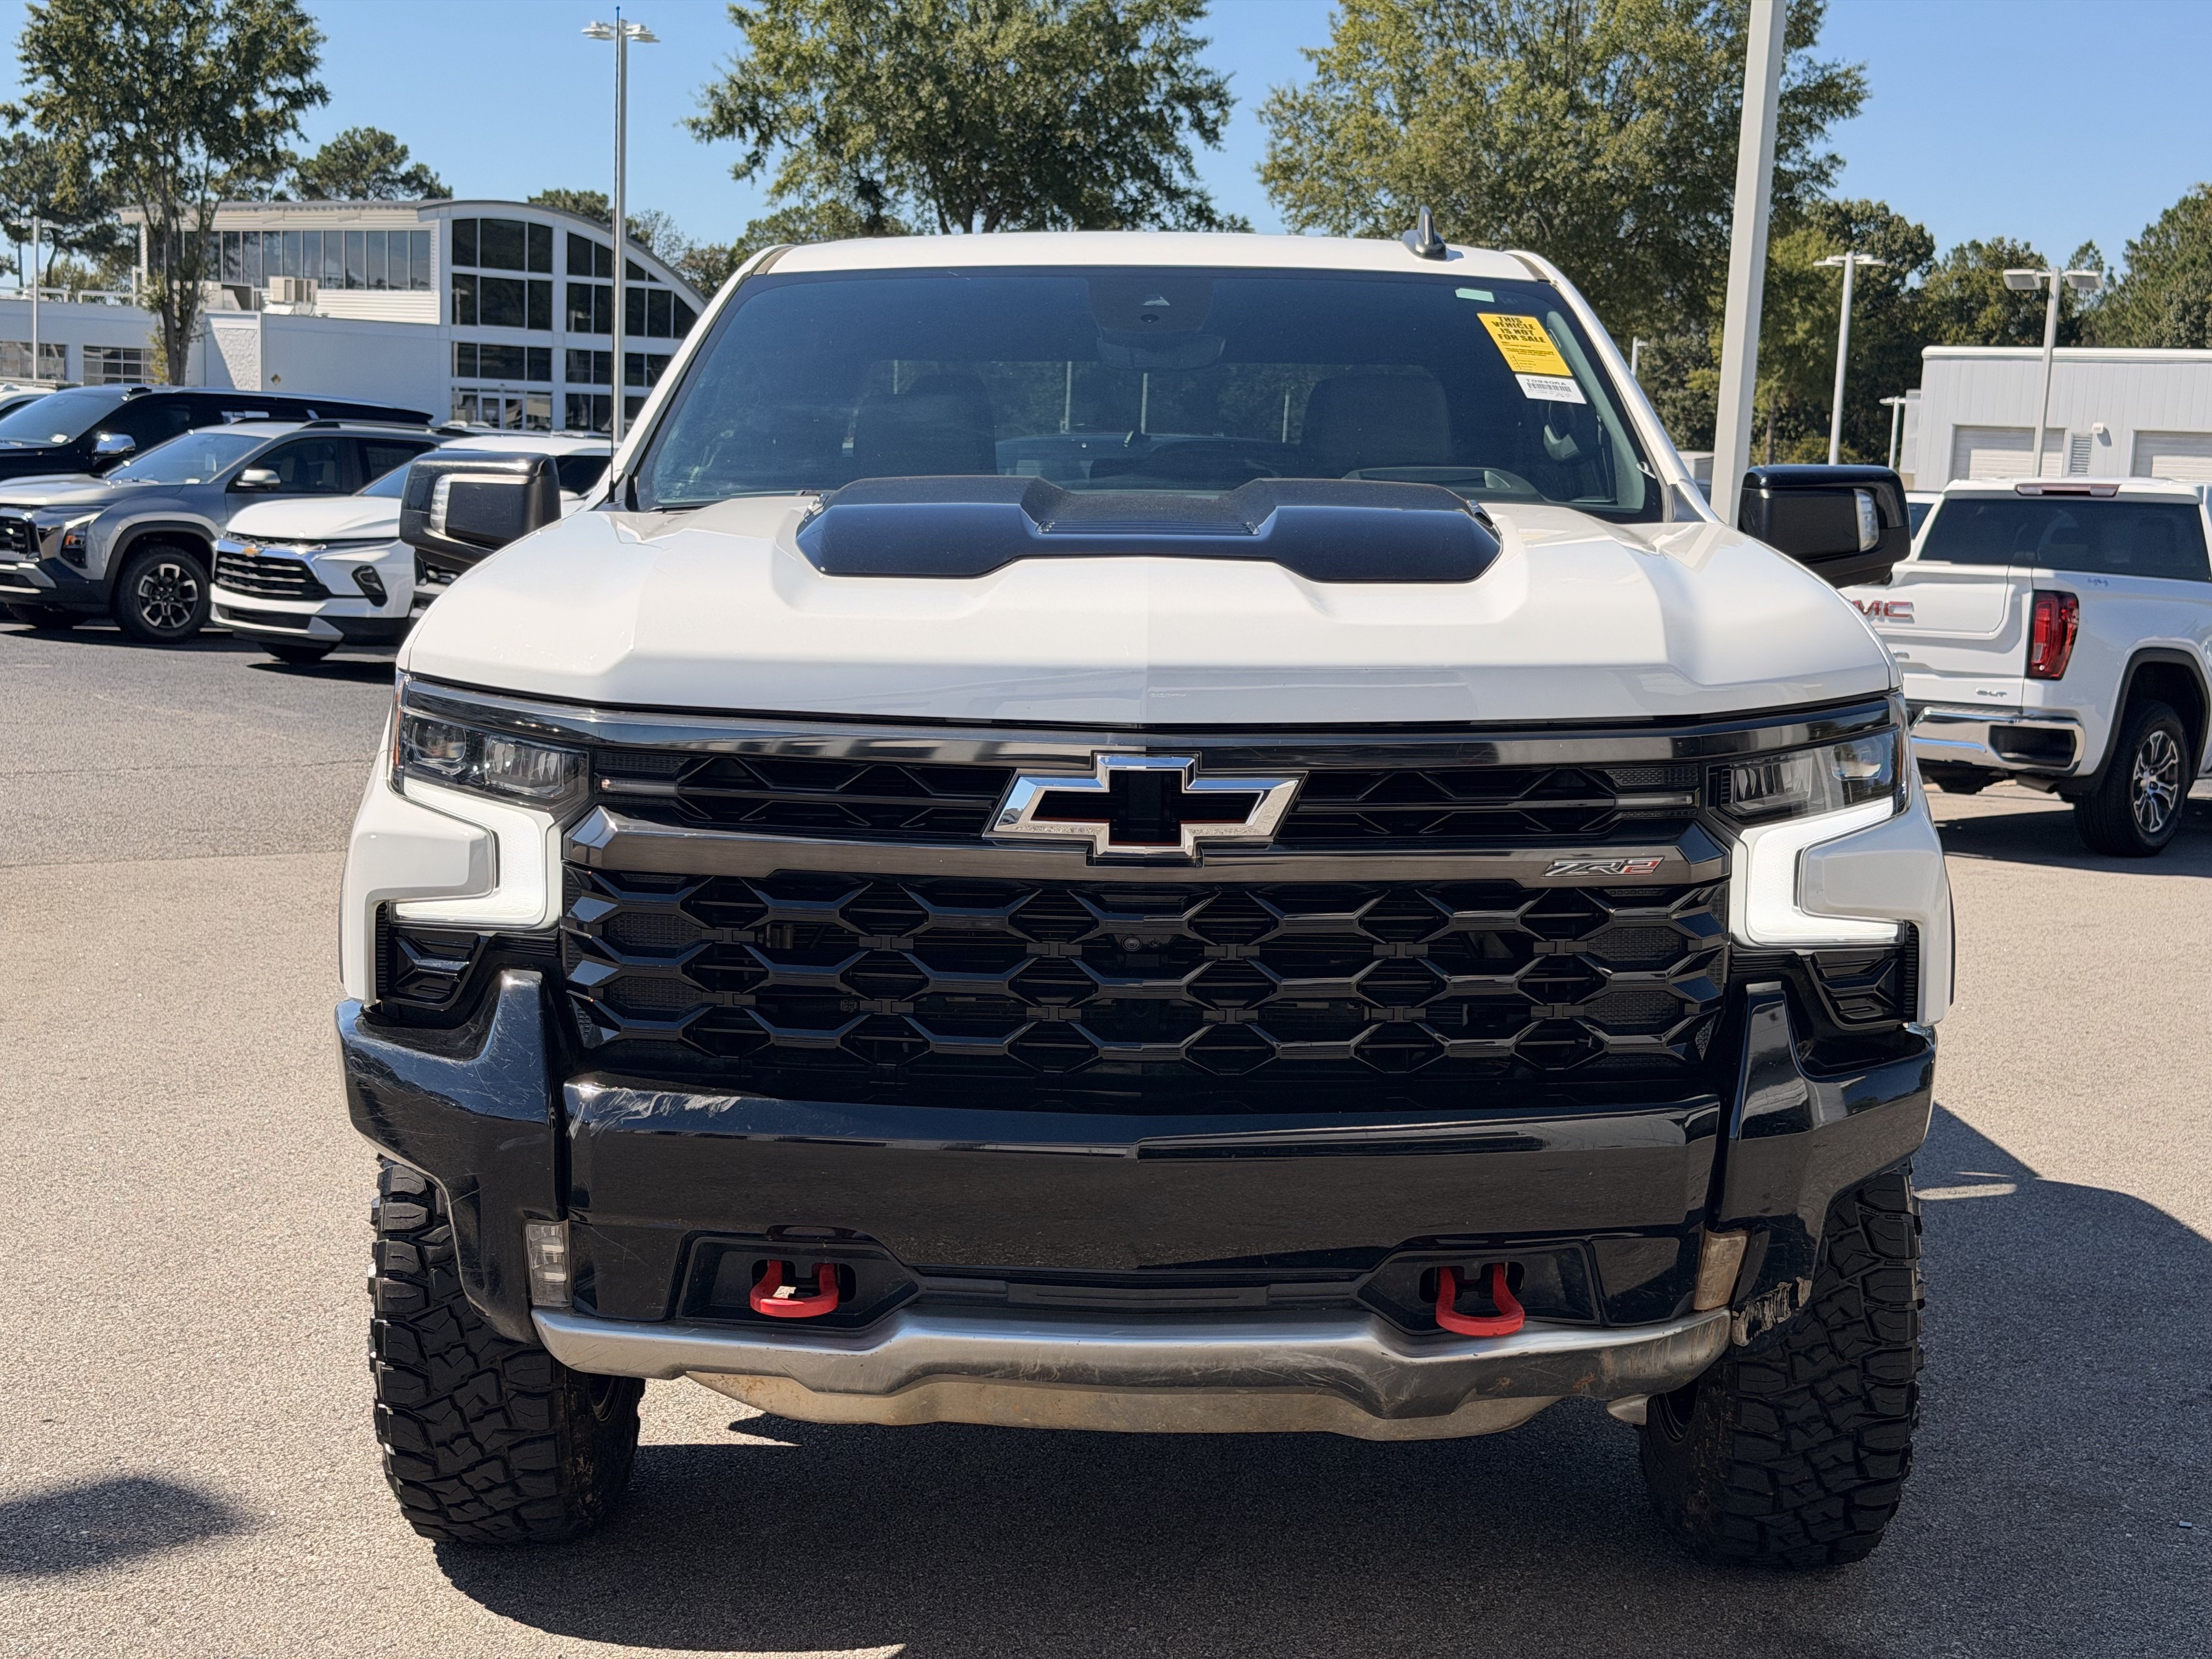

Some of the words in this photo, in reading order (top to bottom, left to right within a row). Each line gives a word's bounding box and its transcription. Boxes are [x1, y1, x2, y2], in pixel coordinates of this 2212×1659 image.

[1491, 321, 1536, 330] VEHICLE
[1851, 600, 1915, 620] MC
[1543, 857, 1662, 877] ZR2
